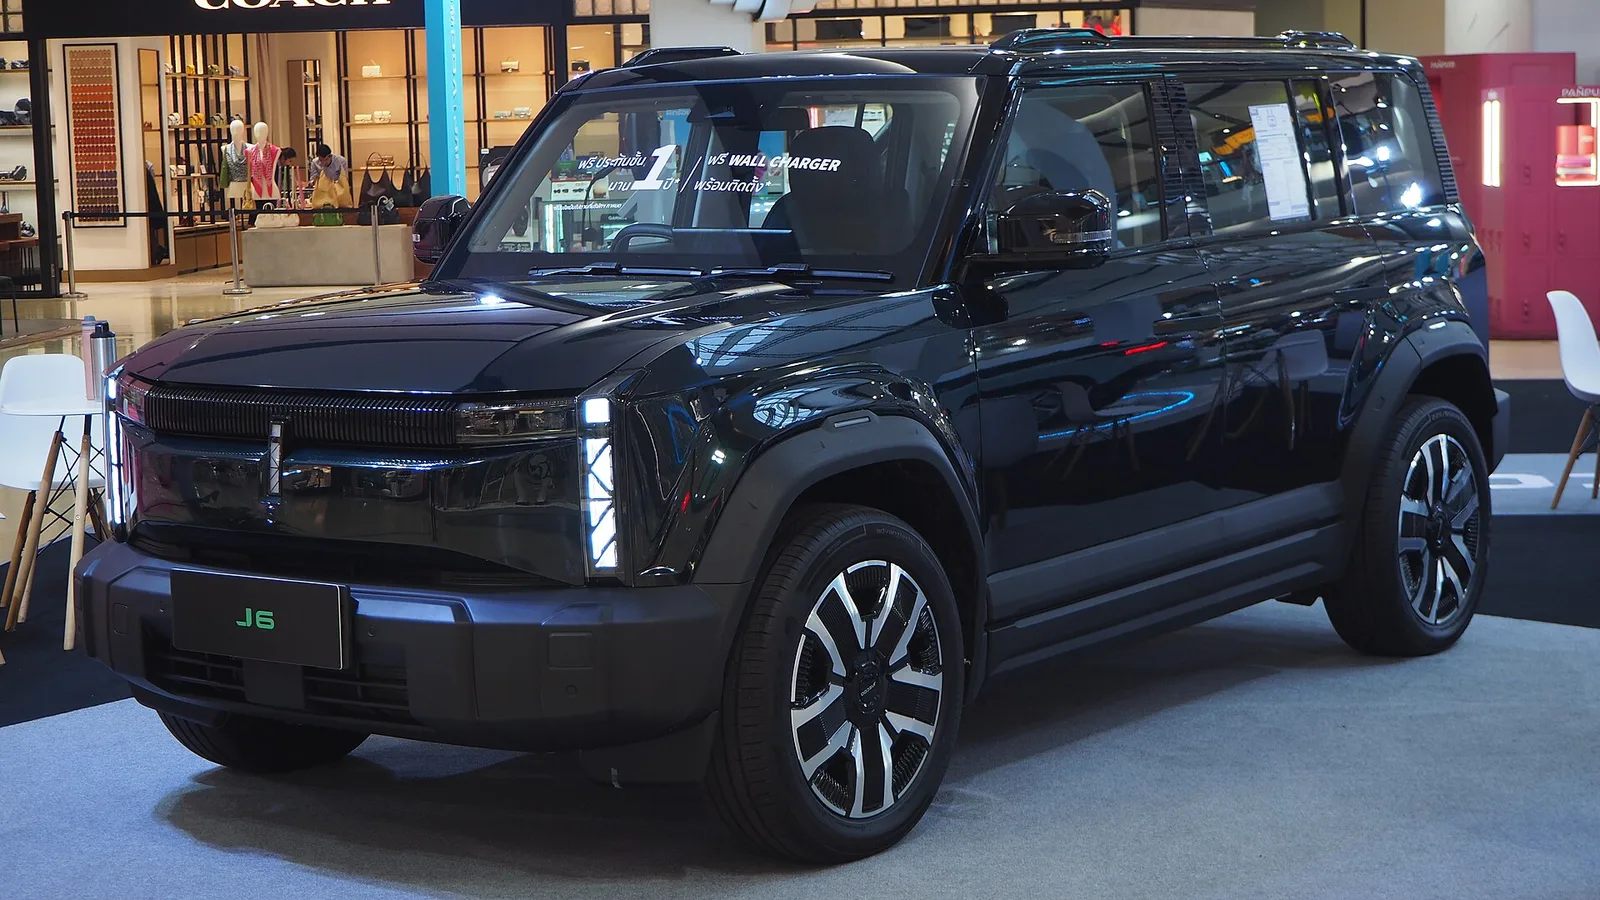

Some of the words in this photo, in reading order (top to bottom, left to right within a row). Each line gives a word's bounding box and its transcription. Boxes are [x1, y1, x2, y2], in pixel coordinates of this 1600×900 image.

[578, 156, 597, 169] ฟรี
[596, 151, 647, 168] ประกันชั้น
[630, 144, 677, 191] 1
[707, 152, 729, 166] ฟรี
[729, 154, 767, 167] WALL
[769, 155, 841, 172] CHARGER
[608, 181, 632, 191] นาน
[235, 607, 275, 630] J6
